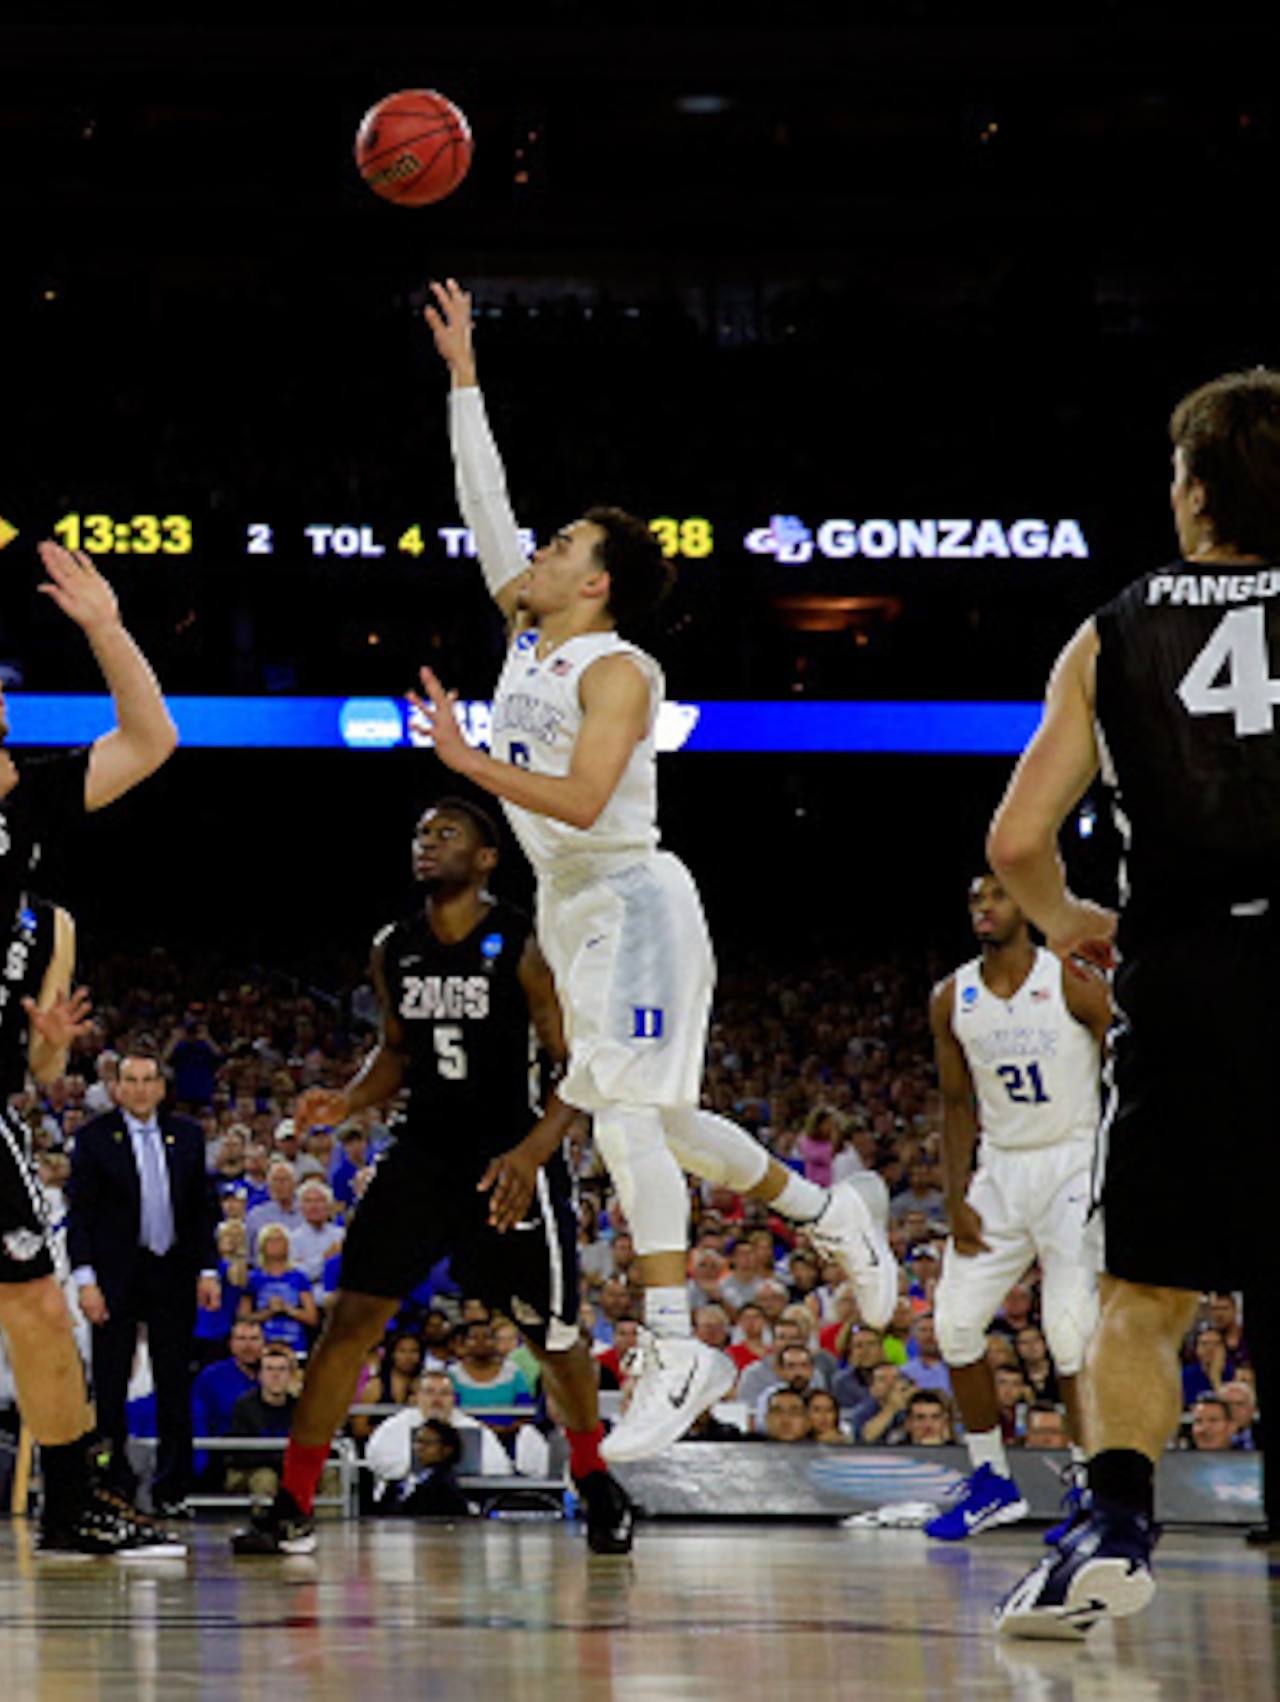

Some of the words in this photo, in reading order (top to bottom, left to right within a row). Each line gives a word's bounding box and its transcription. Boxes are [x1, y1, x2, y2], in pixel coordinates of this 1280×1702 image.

[54, 514, 193, 555] 13:33
[246, 524, 273, 554] 2
[305, 525, 384, 556] TOL
[398, 525, 424, 555] 4
[438, 526, 537, 558] TS
[649, 518, 713, 558] 38
[818, 518, 1089, 559] GONZAGA
[1177, 604, 1280, 736] 4
[400, 975, 490, 1020] ZAGS
[433, 1024, 468, 1080] 5
[996, 1061, 1051, 1104] 21
